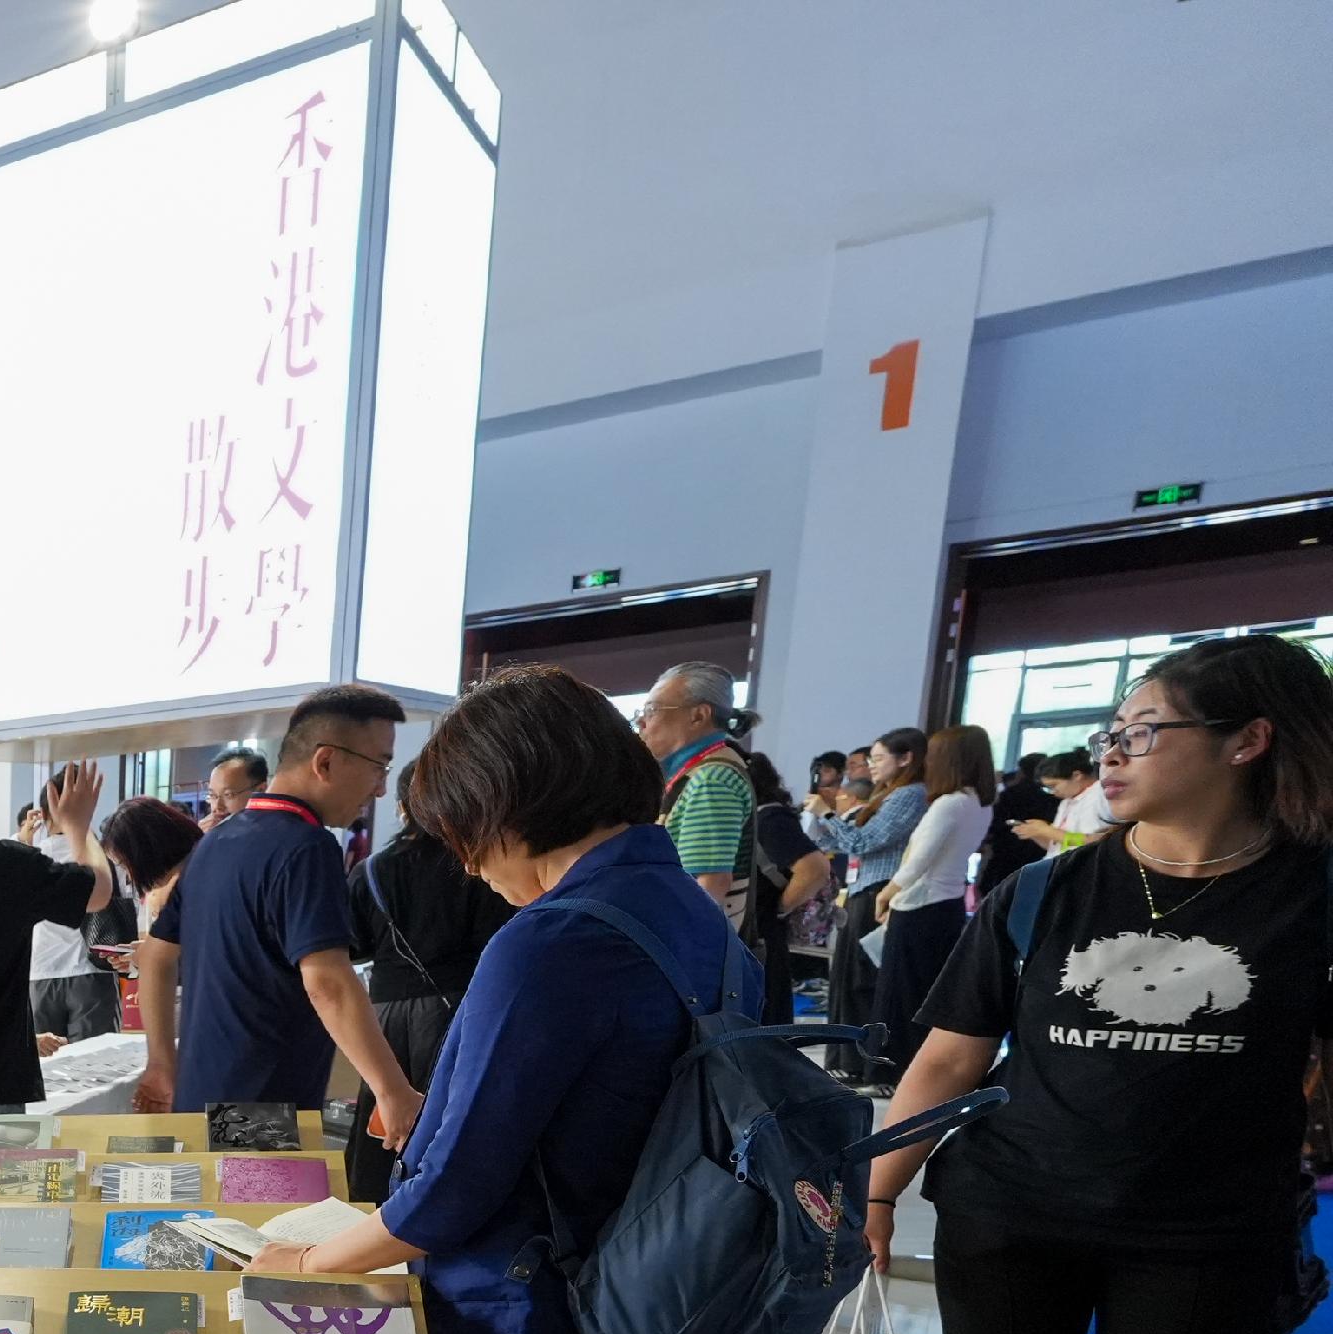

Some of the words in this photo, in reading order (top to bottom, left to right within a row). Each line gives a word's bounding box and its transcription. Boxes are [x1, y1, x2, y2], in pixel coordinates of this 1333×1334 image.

[245, 90, 334, 668] 香港文學
[869, 338, 920, 432] 1
[178, 414, 237, 676] 散步
[1049, 1024, 1246, 1054] HAPPINESS
[73, 1293, 145, 1328] 歸潮
